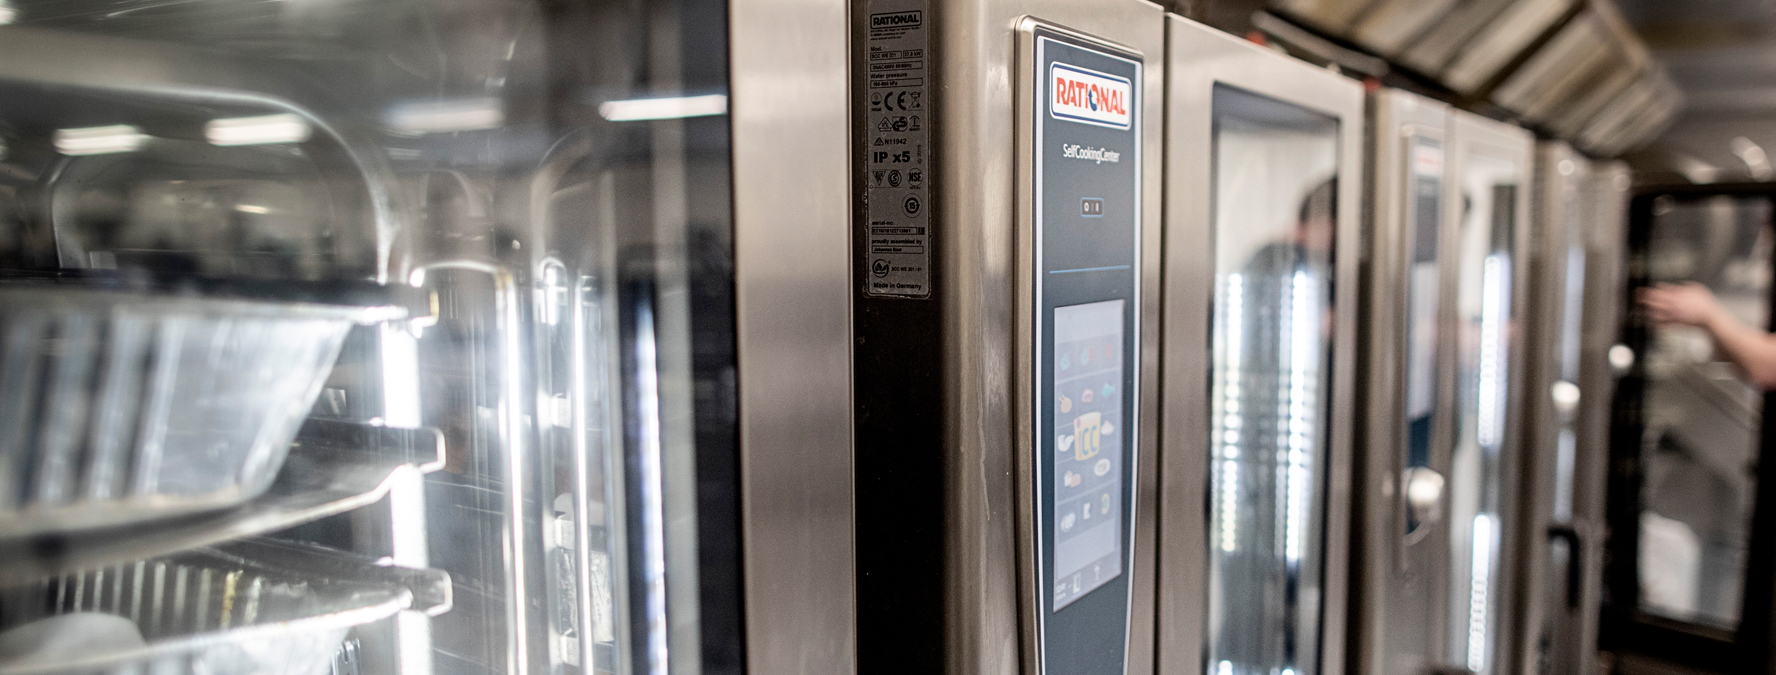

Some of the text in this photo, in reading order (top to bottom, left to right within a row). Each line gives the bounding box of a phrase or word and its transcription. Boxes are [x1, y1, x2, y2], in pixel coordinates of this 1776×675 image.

[873, 14, 919, 26] RATIONAL
[1056, 77, 1126, 115] RATIONAL
[873, 151, 911, 164] IP x5
[1063, 143, 1120, 165] SelfCookingCenter
[908, 172, 921, 182] NSF
[896, 282, 922, 290] Germany
